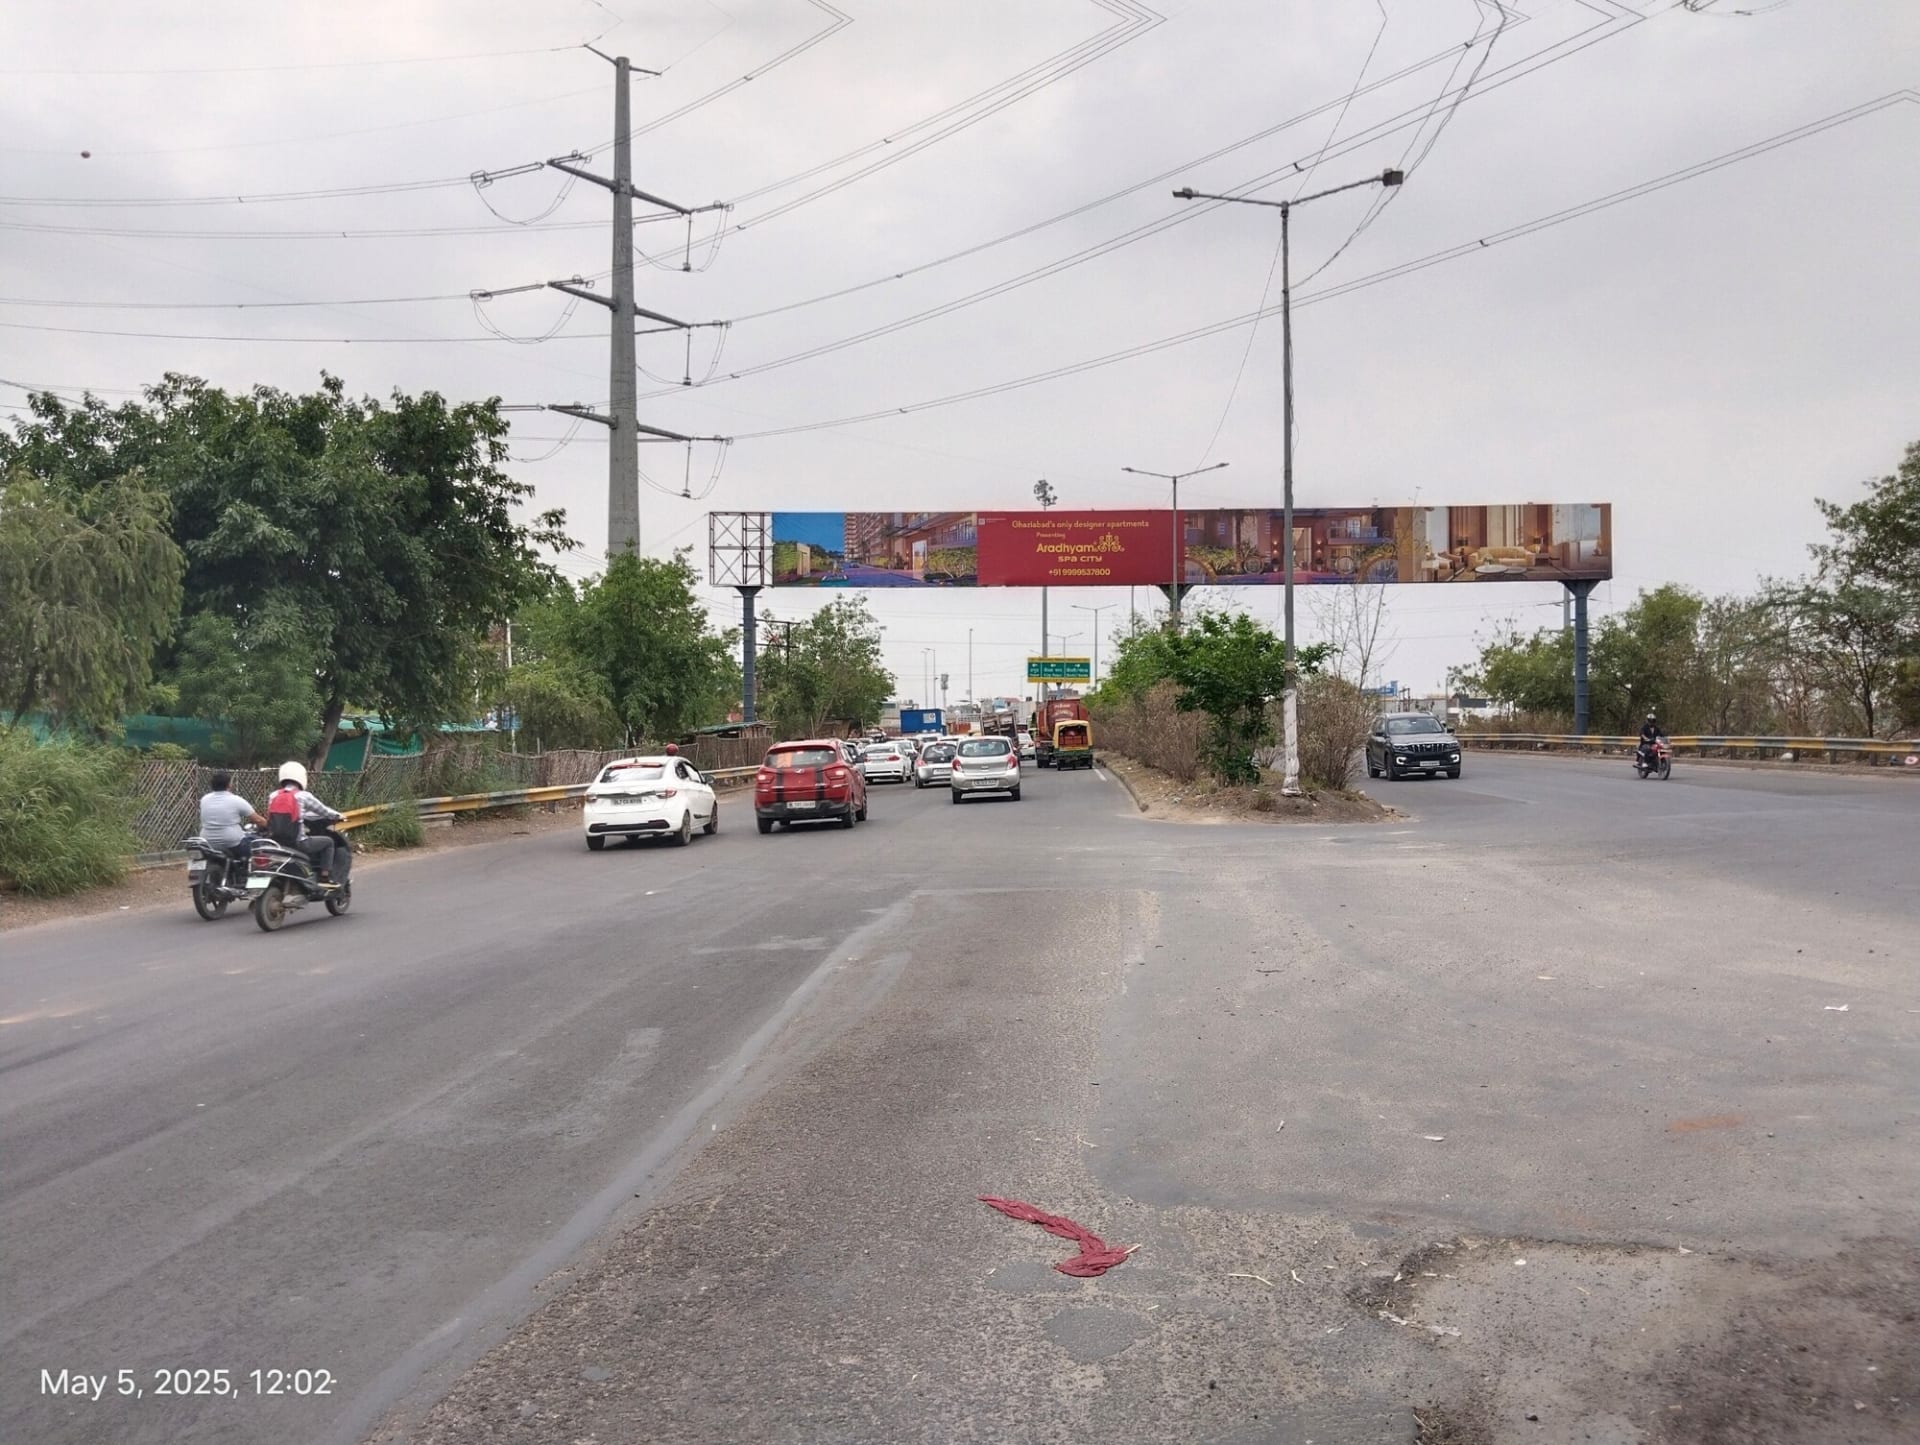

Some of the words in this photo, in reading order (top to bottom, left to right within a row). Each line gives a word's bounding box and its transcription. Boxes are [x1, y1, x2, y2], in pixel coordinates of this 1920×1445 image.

[1012, 520, 1056, 528] Ghaziabad's
[1057, 520, 1073, 530] only
[1074, 520, 1105, 530] designer
[1107, 520, 1149, 529] apartments
[1036, 543, 1094, 554] Aradhyam
